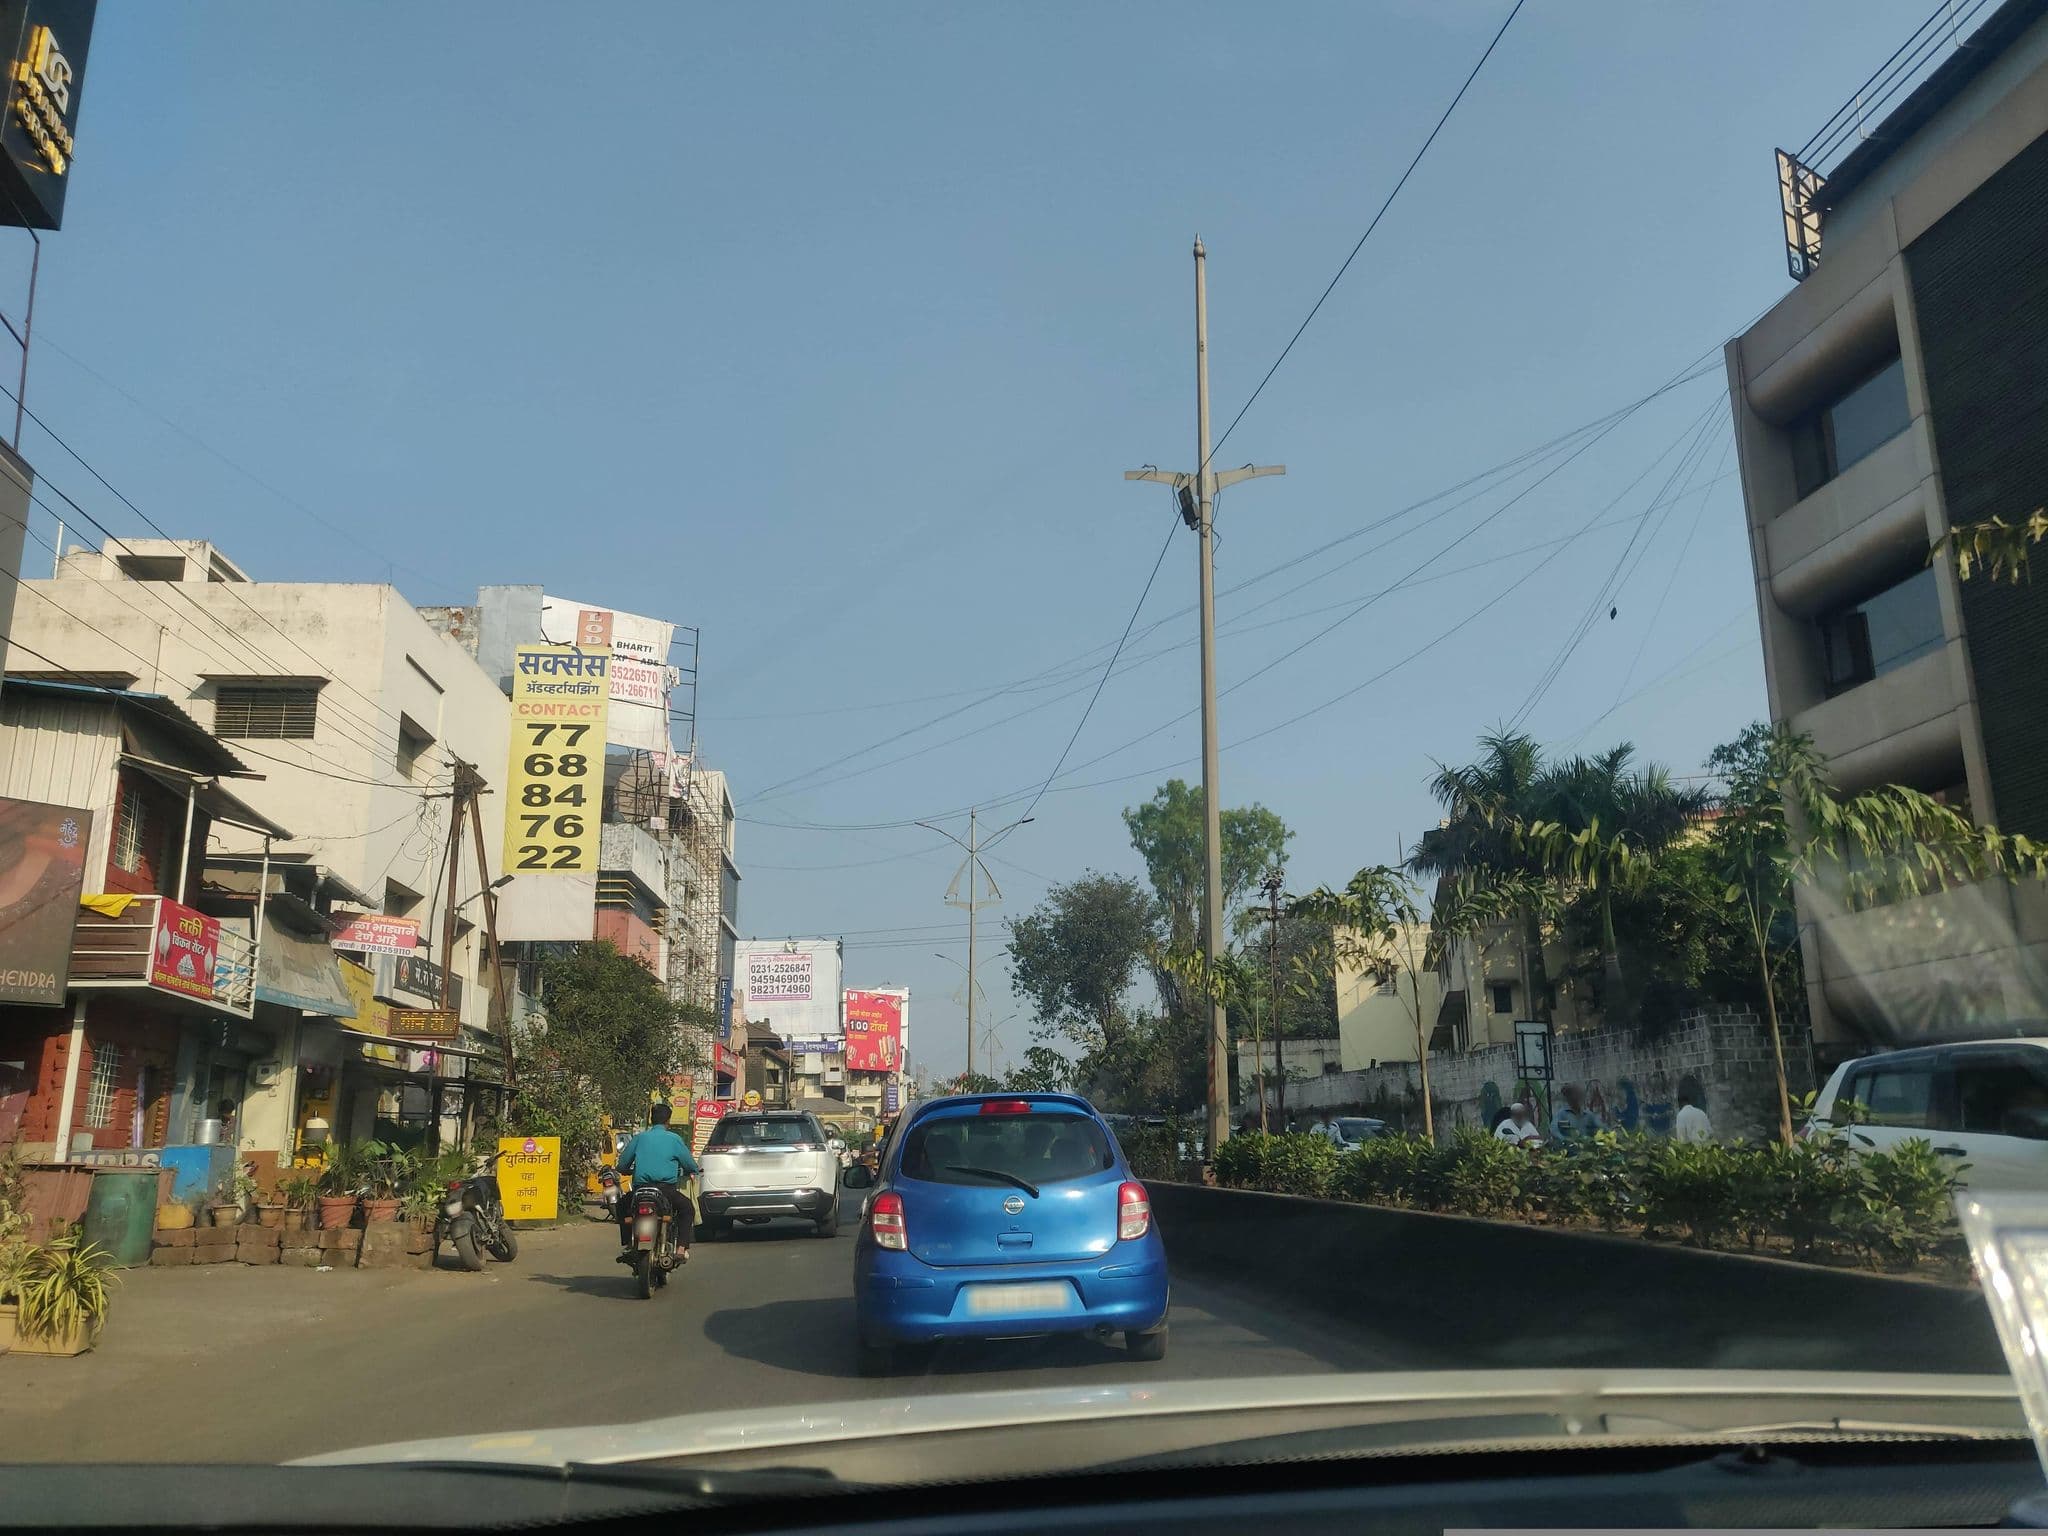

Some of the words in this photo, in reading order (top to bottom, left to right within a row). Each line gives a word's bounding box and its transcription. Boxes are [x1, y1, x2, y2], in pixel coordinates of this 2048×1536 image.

[616, 641, 652, 653] BHARTI
[518, 647, 609, 677] सक्सेस
[518, 703, 601, 717] CONTACT
[527, 724, 590, 747] 77
[524, 753, 588, 777] 68
[521, 783, 587, 808] 84
[520, 814, 584, 838] 76
[516, 845, 582, 869] 22
[751, 974, 811, 984] 9459469090
[751, 984, 811, 994] 9823174960
[850, 1020, 868, 1031] 100
